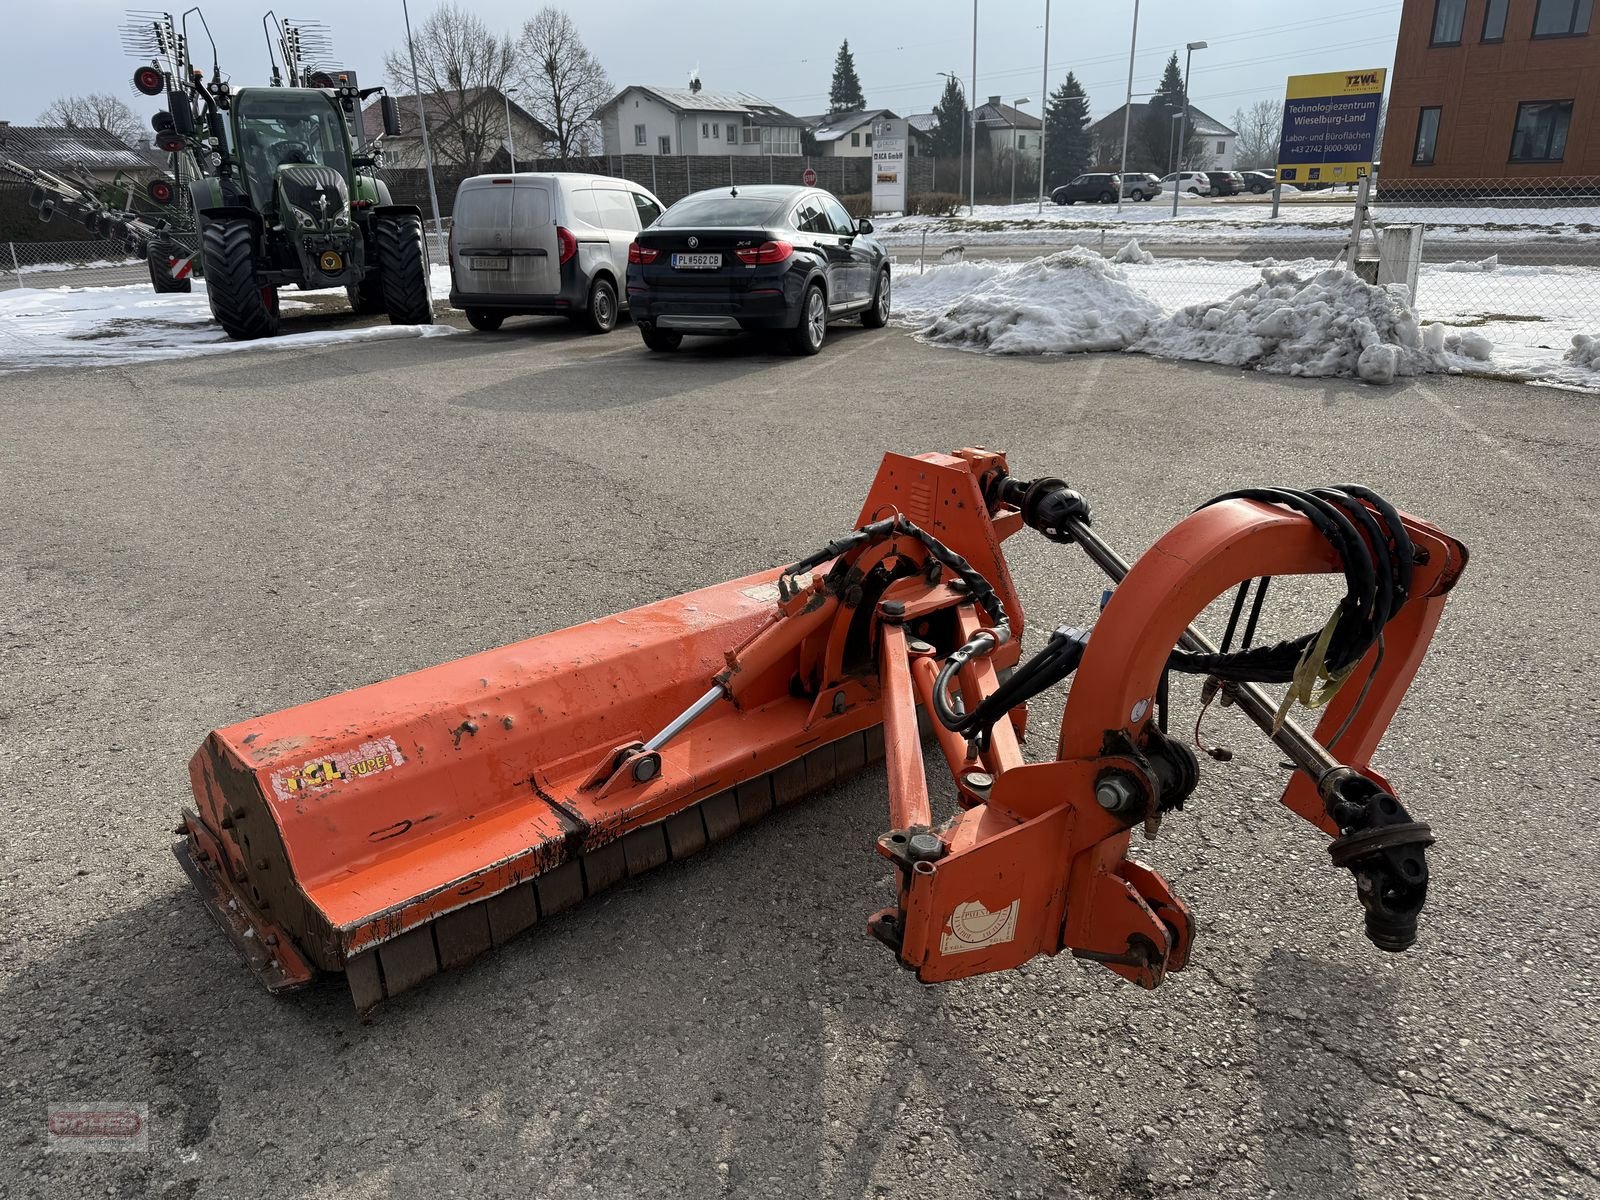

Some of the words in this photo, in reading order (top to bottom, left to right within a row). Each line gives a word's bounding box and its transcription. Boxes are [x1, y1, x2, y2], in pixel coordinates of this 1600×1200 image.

[1346, 72, 1378, 86] TZWL
[1289, 101, 1375, 113] Technologiezentrum
[1294, 113, 1366, 125] Wieselburg-Land
[1285, 133, 1308, 142] Labor-
[1310, 132, 1323, 141] und
[1326, 131, 1371, 141] Büroflächen
[1291, 145, 1303, 153] +43
[1305, 145, 1322, 153] 2742
[1324, 144, 1361, 152] 9000-9001
[888, 151, 903, 160] GmbH
[678, 255, 687, 264] PL
[693, 255, 707, 264] 562
[709, 255, 719, 264] CB
